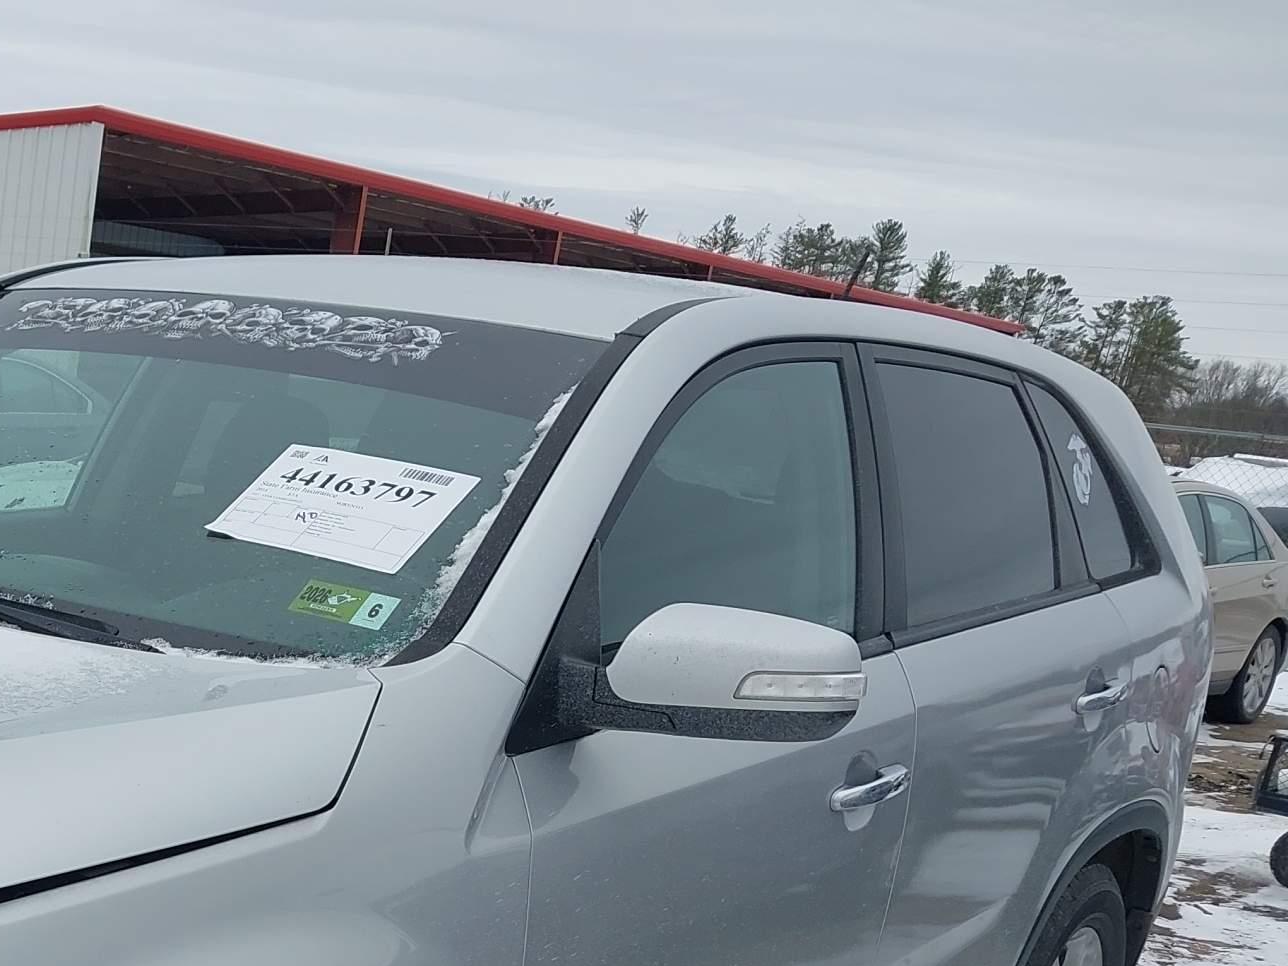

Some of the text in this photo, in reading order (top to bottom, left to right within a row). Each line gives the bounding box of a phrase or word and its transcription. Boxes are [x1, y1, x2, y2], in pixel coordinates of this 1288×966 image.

[280, 467, 437, 508] 44163797
[300, 585, 331, 605] 2026
[367, 603, 384, 619] 6
